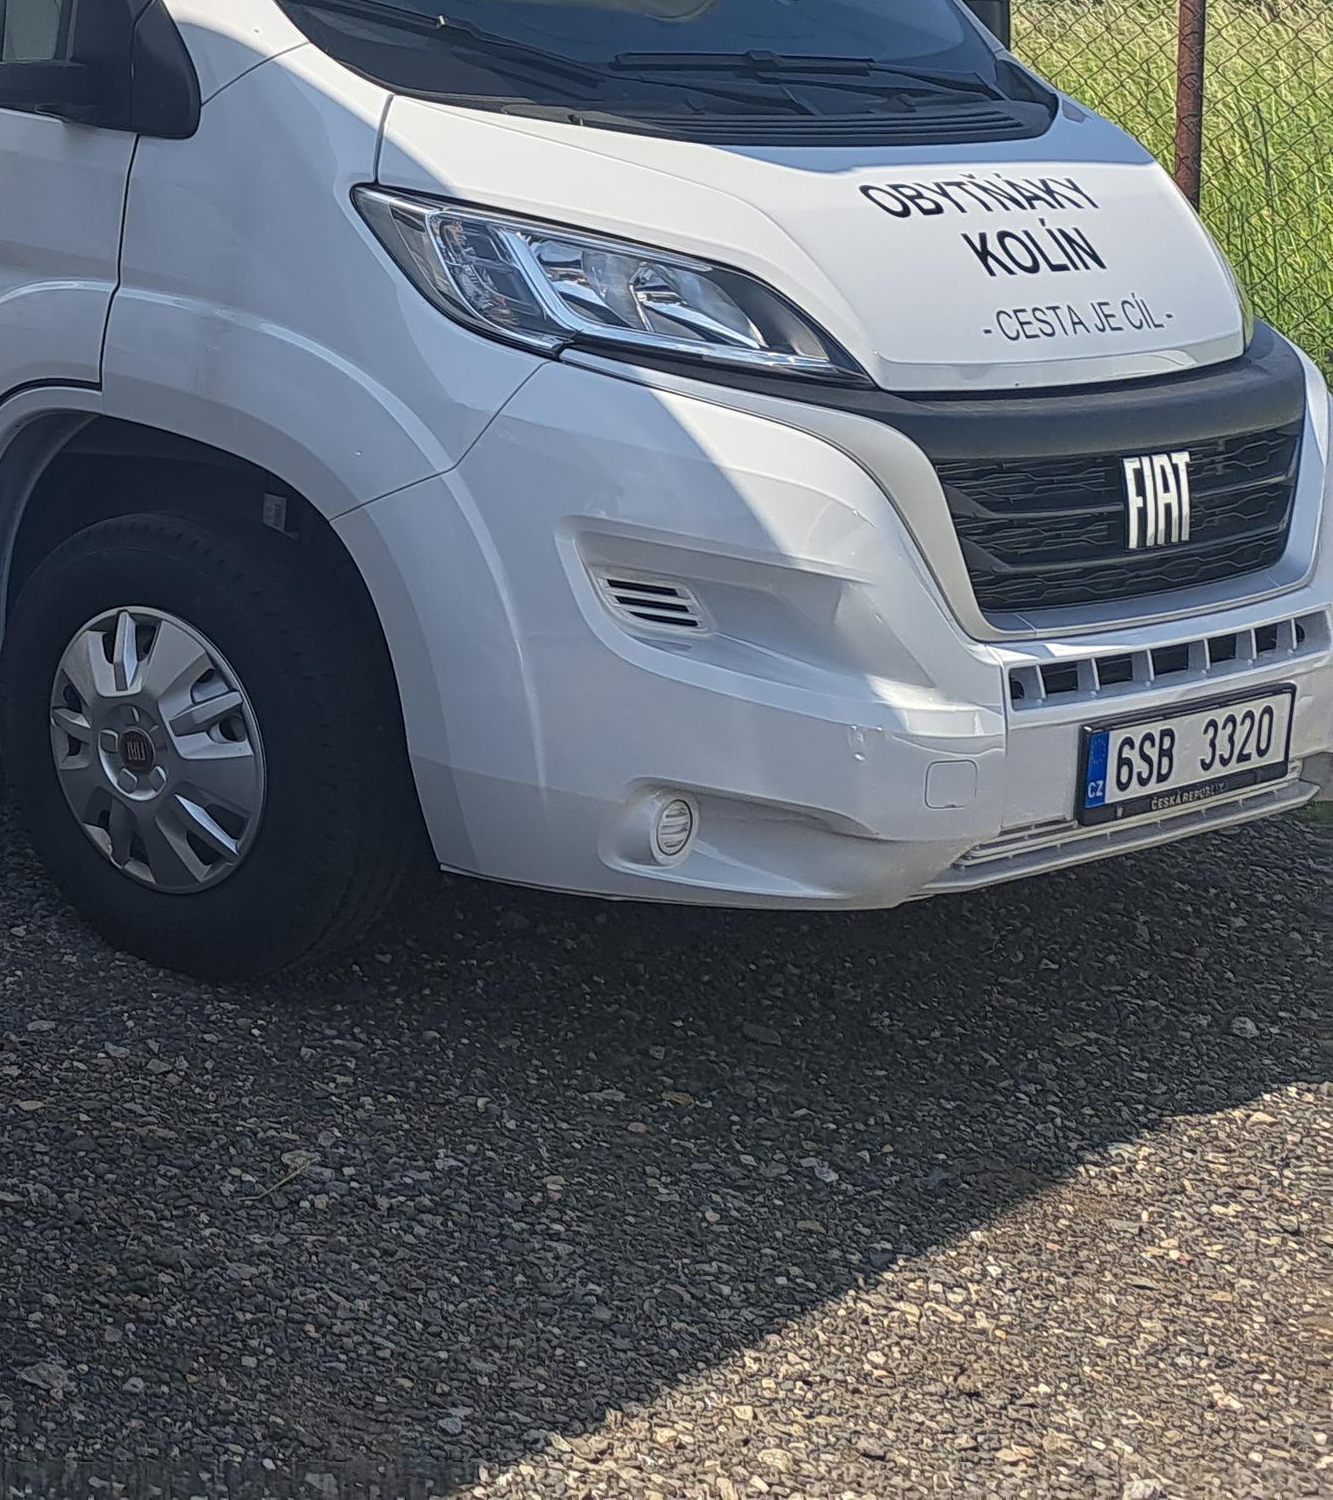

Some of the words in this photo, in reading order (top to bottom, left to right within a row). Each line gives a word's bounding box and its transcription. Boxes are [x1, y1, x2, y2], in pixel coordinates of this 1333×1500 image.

[858, 172, 1100, 219] OBYTŇÁKY
[960, 217, 1108, 277] KOLÍN
[995, 304, 1091, 342] CESTA
[1093, 301, 1124, 333] JE
[1121, 292, 1164, 331] CÍL
[1122, 451, 1191, 549] FIAT
[1116, 727, 1176, 793] 6SB
[1200, 704, 1275, 772] 3320
[1087, 779, 1105, 798] CZ
[1150, 789, 1182, 811] ČESKÁ
